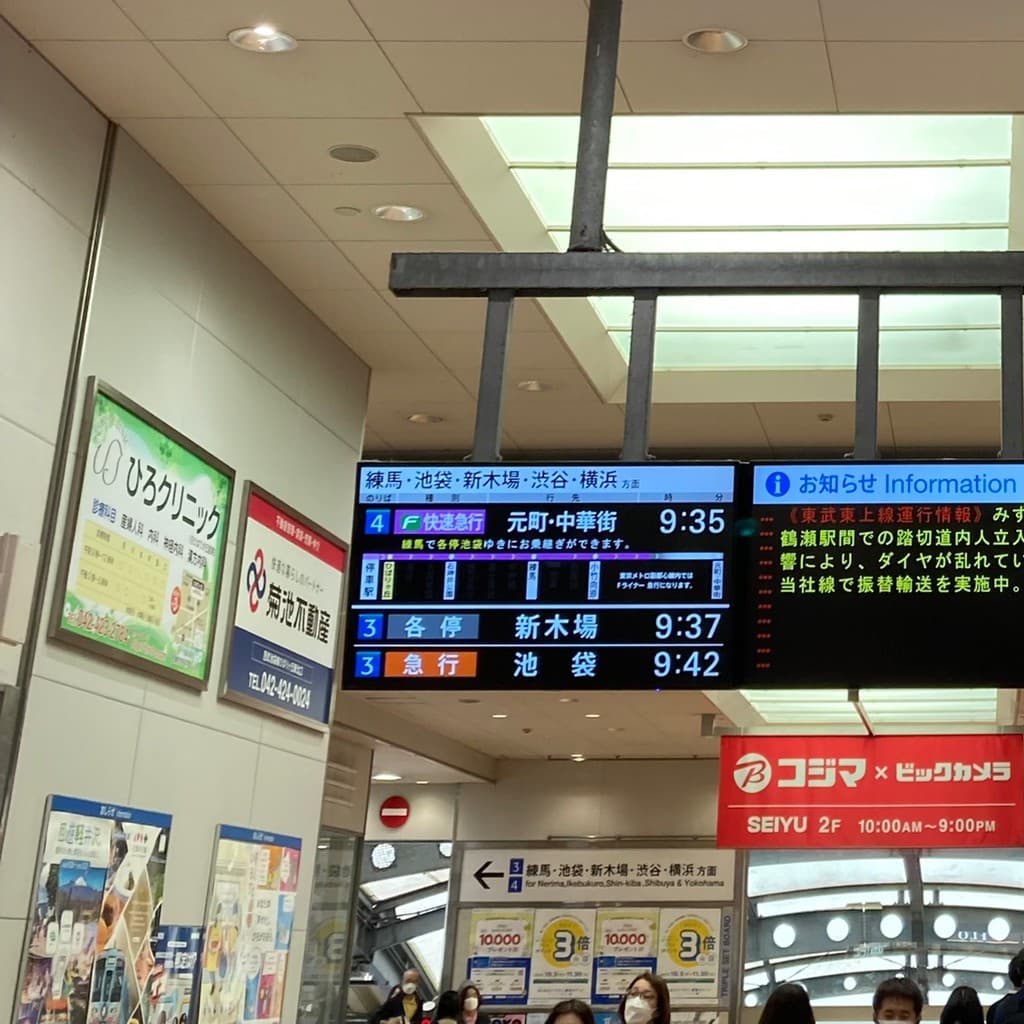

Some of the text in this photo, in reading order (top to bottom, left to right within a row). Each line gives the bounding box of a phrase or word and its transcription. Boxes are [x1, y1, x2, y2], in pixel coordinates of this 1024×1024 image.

[799, 472, 1017, 494] お知らせ Information
[126, 456, 221, 540] ひろクリニック
[371, 514, 384, 533] 4
[423, 513, 483, 532] 快速急行
[507, 510, 617, 533] 元町・中華街
[659, 508, 726, 534] 9:35
[780, 576, 1021, 594] 当社線で振替輸送を実施中。
[266, 582, 331, 644] 菊池不動産
[363, 619, 377, 637] 3
[514, 614, 599, 640] 新木場
[655, 613, 721, 640] 9:37
[360, 656, 374, 676] 3
[653, 651, 720, 678] 9:42
[777, 757, 867, 788] コジマ
[896, 761, 1011, 783] ビックカメラ
[747, 816, 808, 833] SEIYU
[819, 817, 841, 833] 2F
[512, 861, 520, 872] 3
[511, 880, 518, 891] 4
[525, 879, 537, 887] for
[685, 879, 724, 887] Yokohama
[723, 915, 731, 946] BOARD
